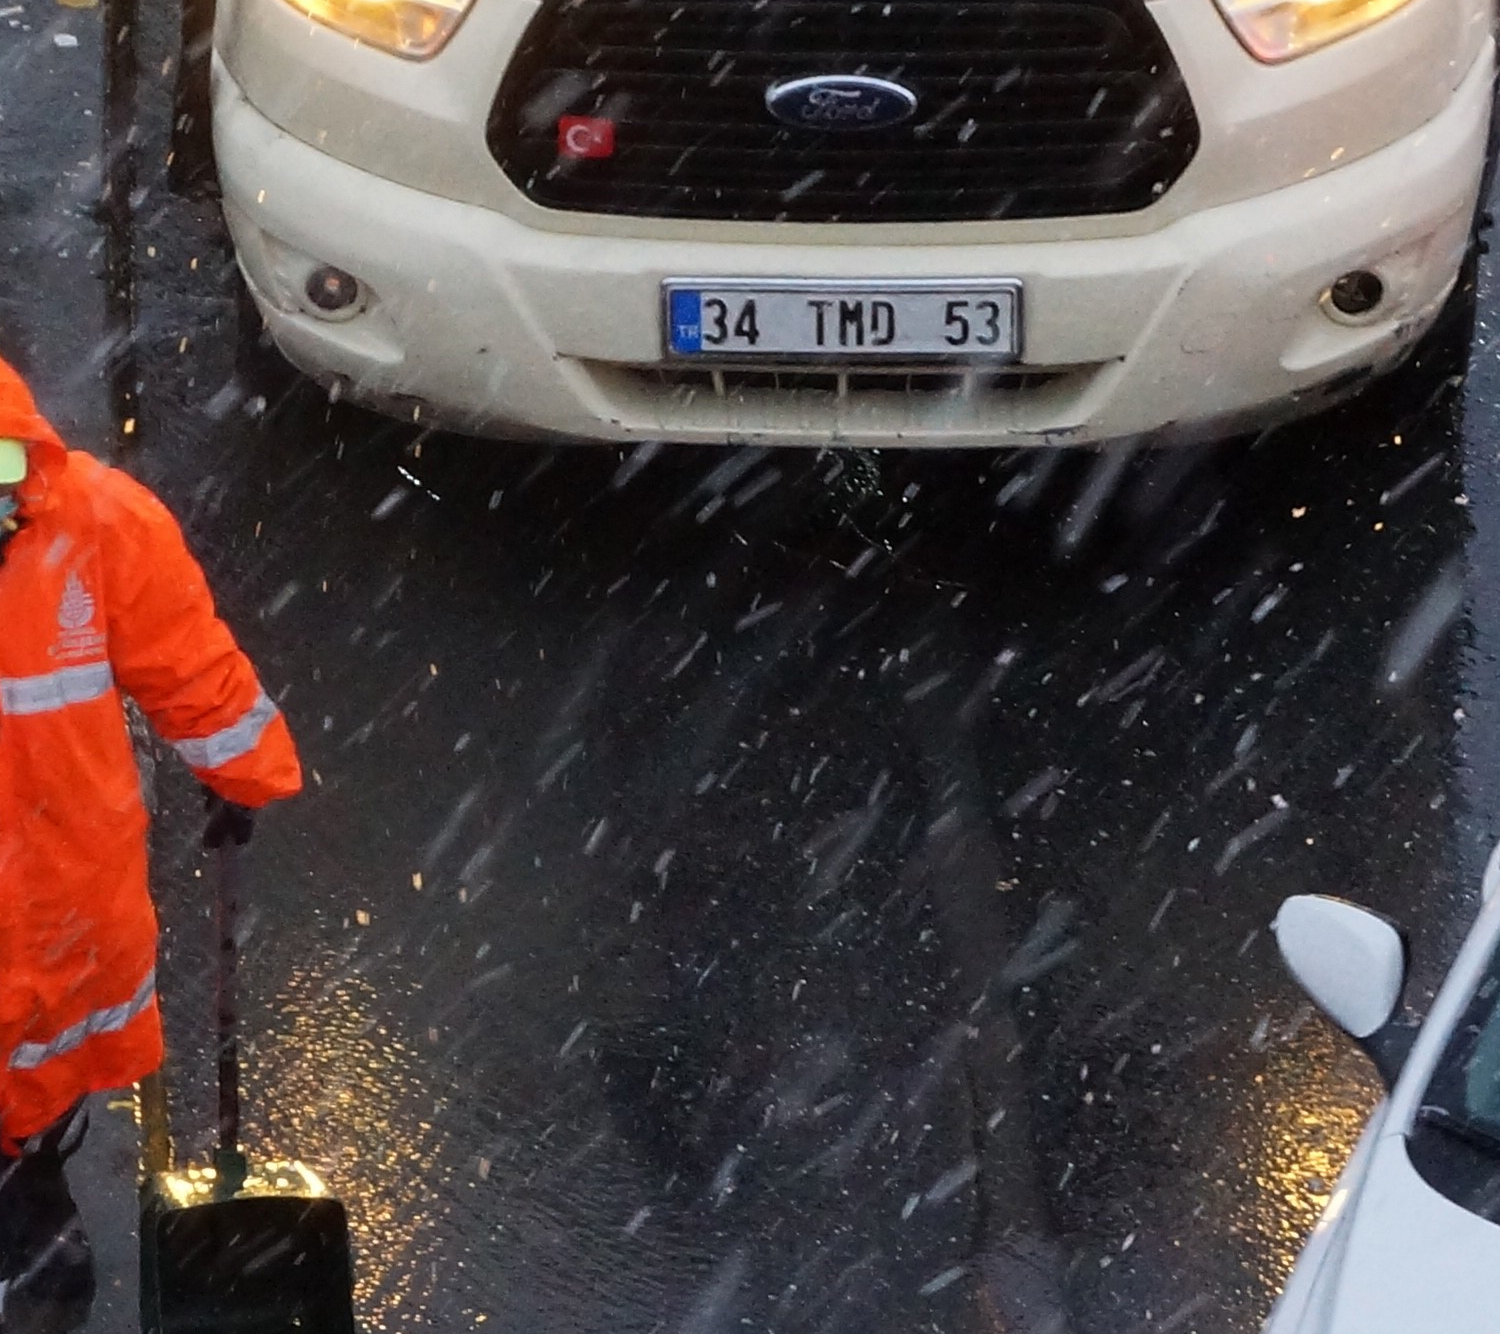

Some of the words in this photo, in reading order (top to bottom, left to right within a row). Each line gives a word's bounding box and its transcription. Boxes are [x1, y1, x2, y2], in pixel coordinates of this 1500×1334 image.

[703, 298, 760, 345] 34
[807, 300, 895, 346] TMD
[943, 300, 1000, 346] 53
